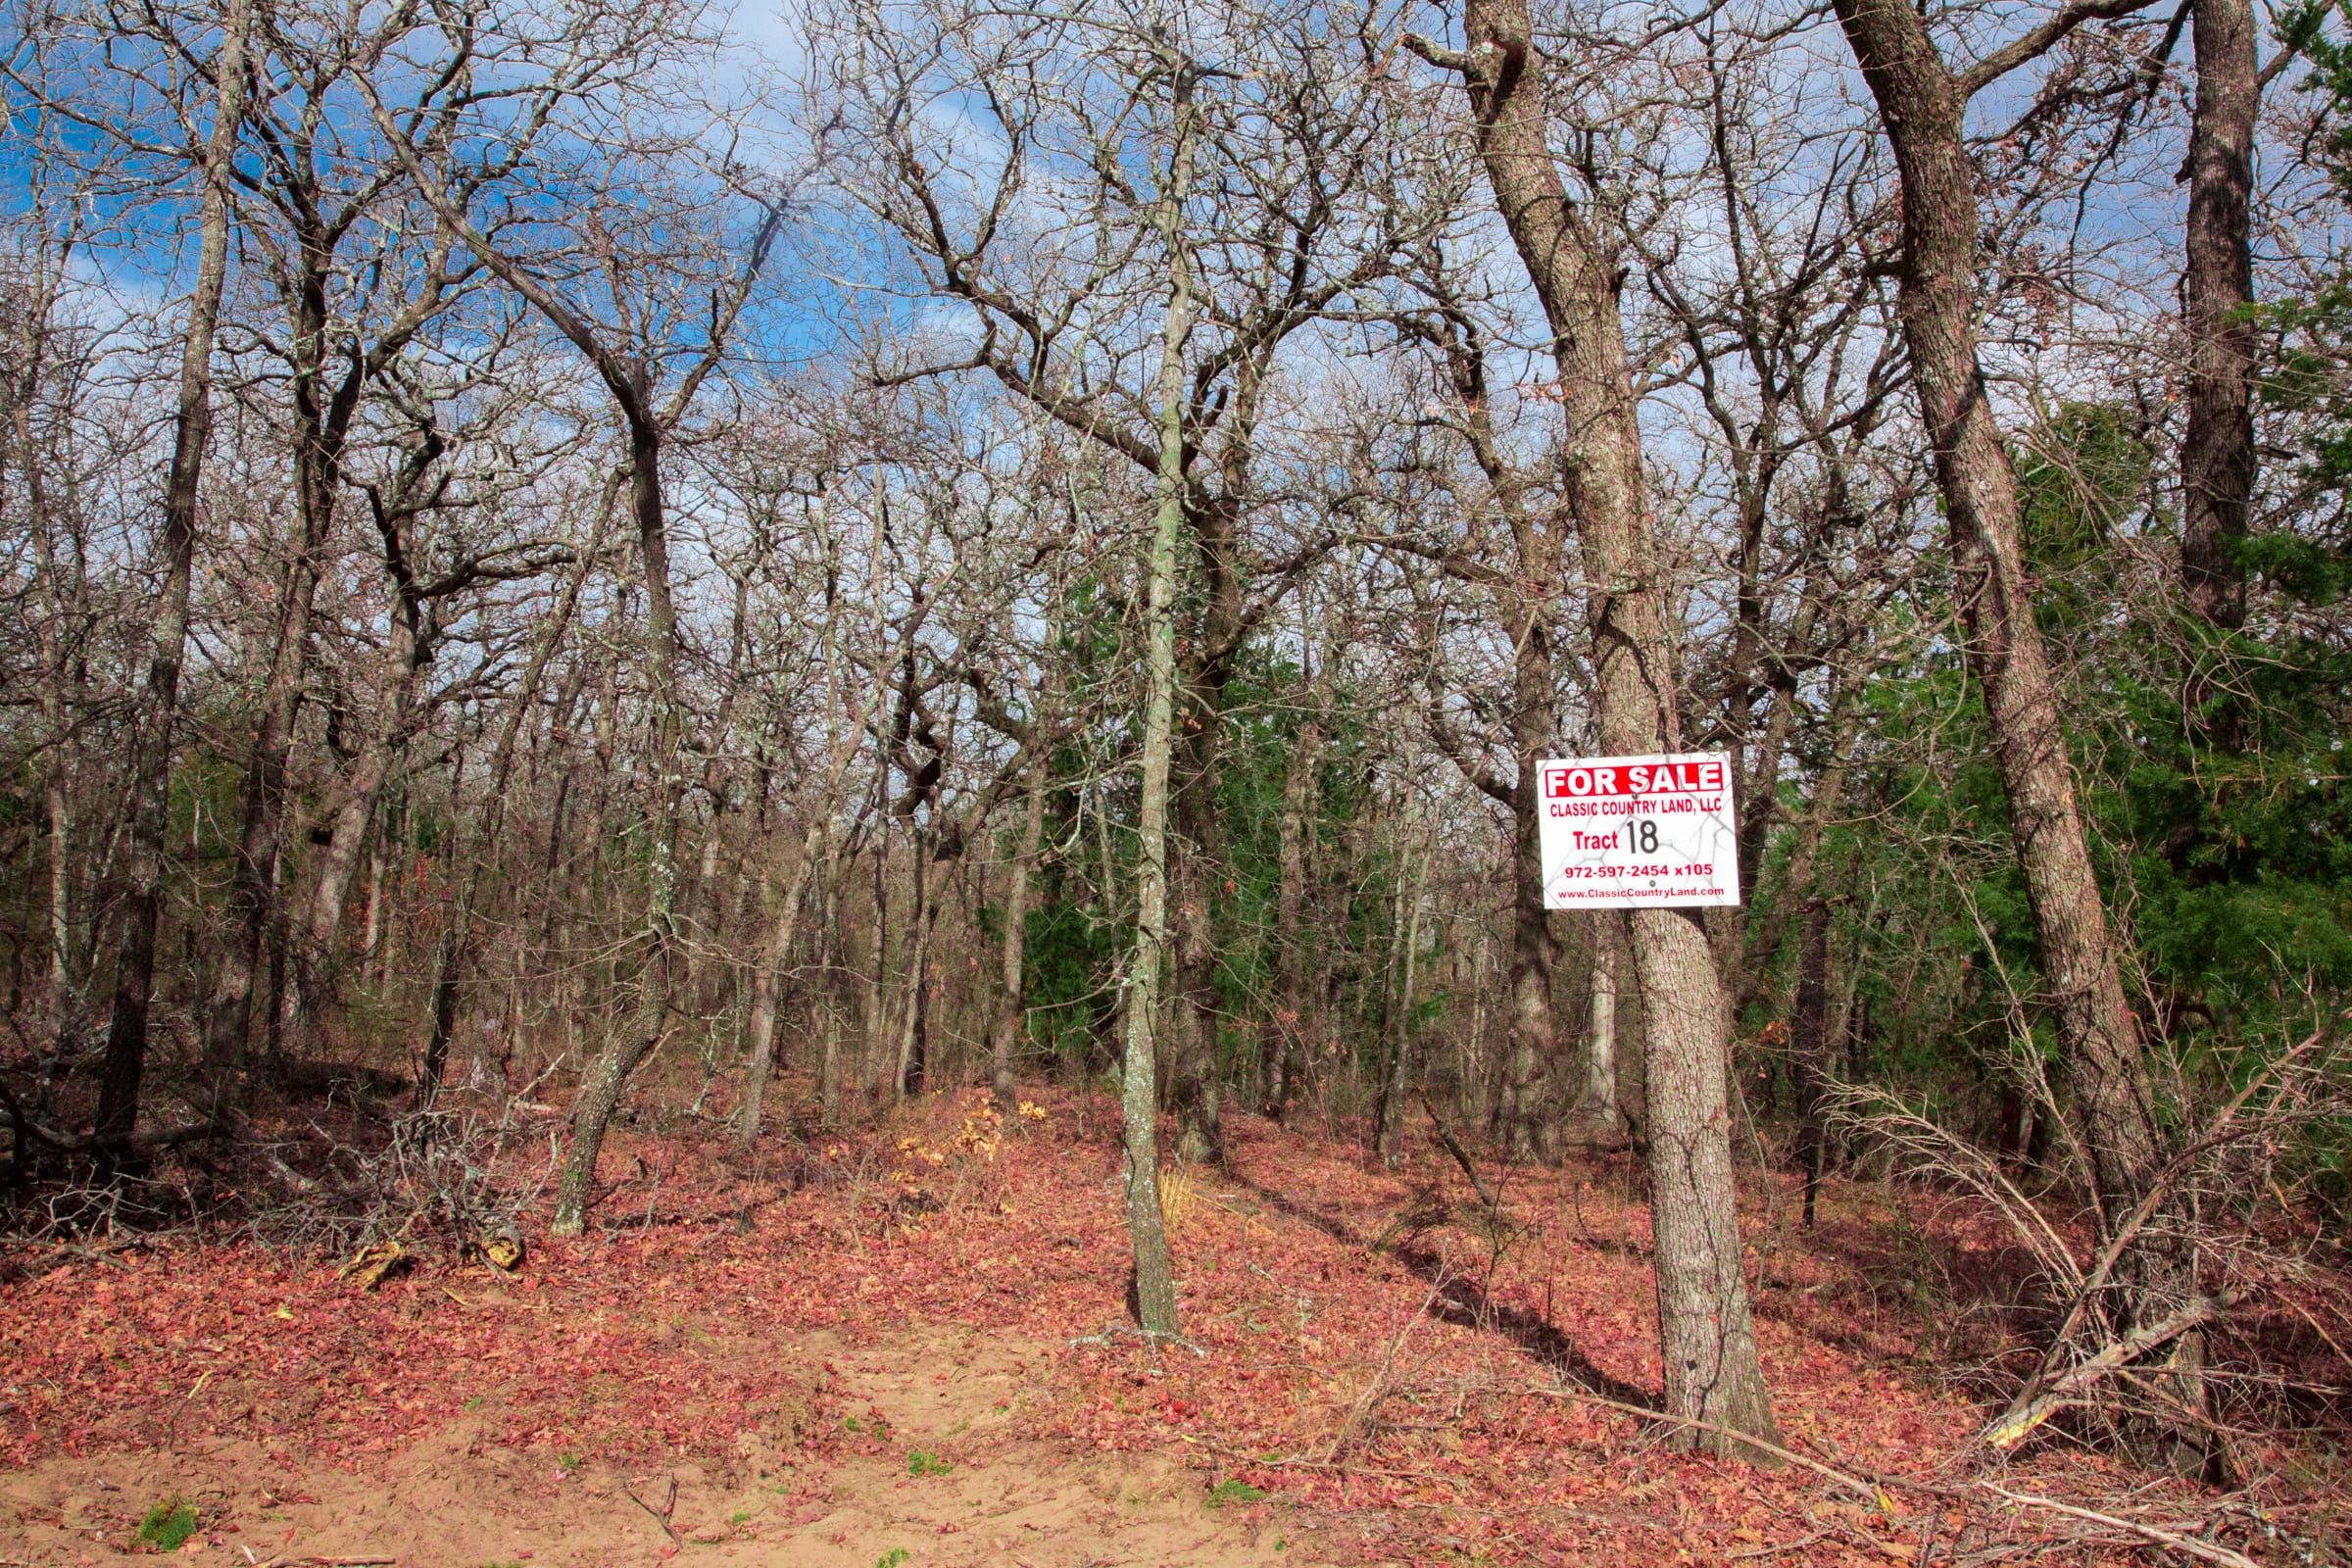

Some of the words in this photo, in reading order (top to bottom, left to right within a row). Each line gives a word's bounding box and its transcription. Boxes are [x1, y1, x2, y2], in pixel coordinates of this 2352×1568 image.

[1547, 768, 1618, 796] FOR
[1629, 763, 1721, 793] SALE
[1550, 803, 1597, 817] CLASSIC
[1603, 801, 1657, 815] COUNTRY
[1662, 800, 1696, 814] LAND,
[1700, 798, 1722, 811] LLC
[1573, 830, 1618, 850] Tract
[1627, 820, 1658, 854] 18
[1565, 865, 1668, 878] 972-597-2454
[1675, 864, 1713, 876] x105
[1558, 888, 1724, 898] www.ClassicCountryLand.com
